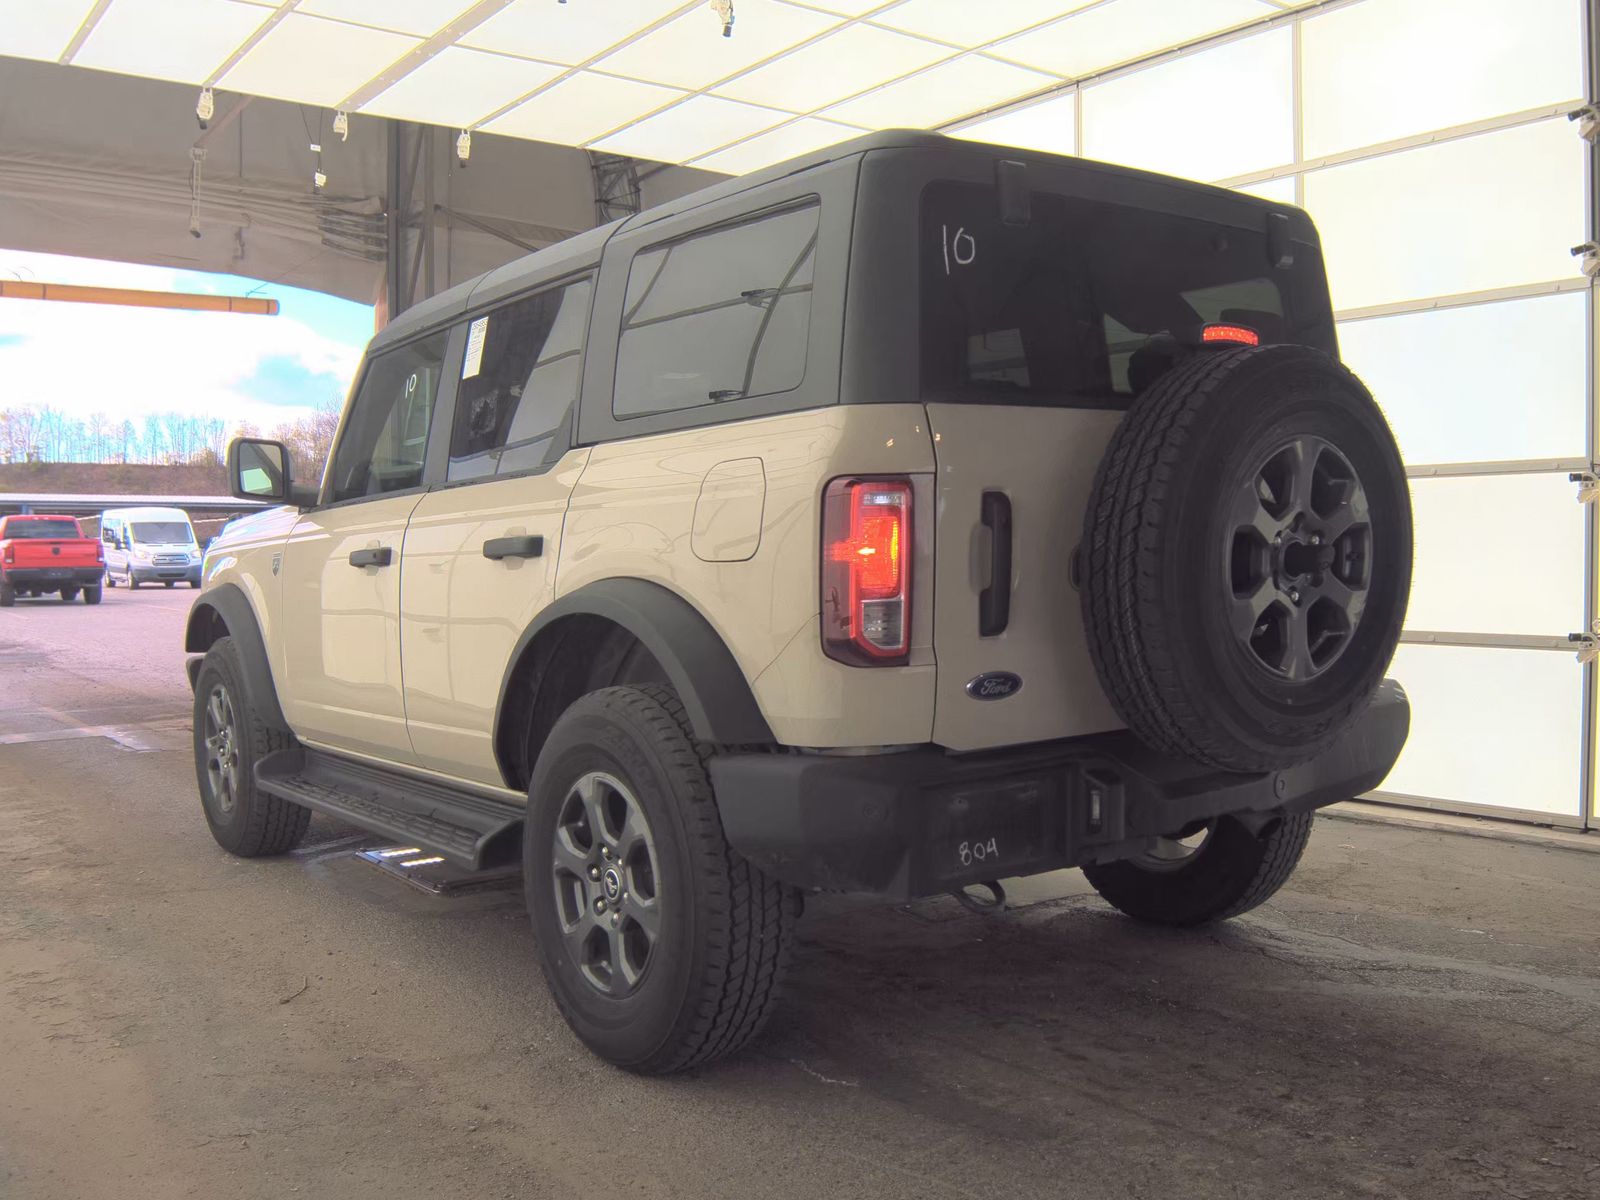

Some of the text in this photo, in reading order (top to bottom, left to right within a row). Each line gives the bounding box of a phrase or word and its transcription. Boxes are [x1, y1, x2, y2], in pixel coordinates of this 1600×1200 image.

[943, 224, 976, 276] 10
[405, 373, 417, 399] 10
[980, 678, 1013, 695] Ford
[959, 837, 999, 866] 804
